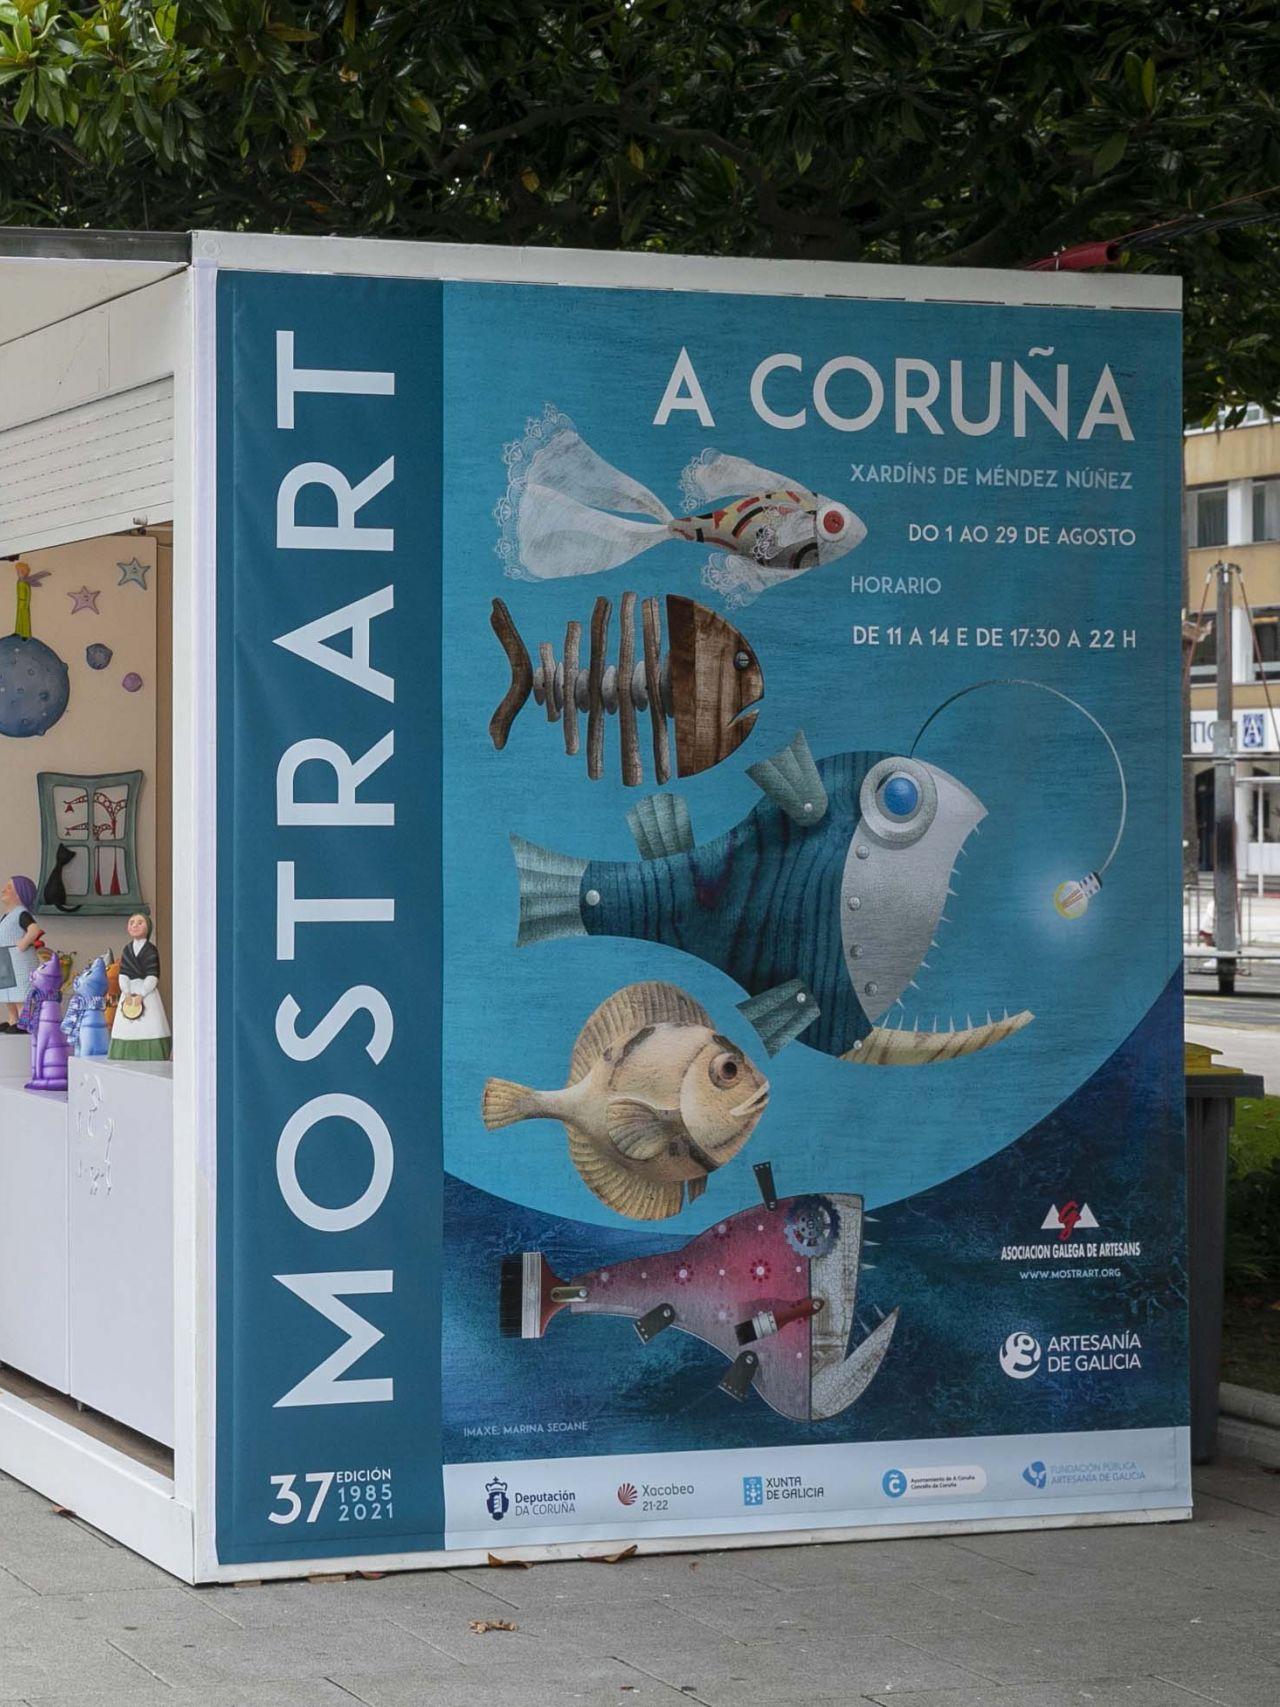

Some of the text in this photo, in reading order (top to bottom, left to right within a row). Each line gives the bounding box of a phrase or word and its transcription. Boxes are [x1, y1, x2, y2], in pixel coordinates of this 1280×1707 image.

[653, 346, 1135, 442] A CORUÑA
[850, 461, 1133, 491] XARDÍNS DE MÉNDEZ NÚÑEZ
[908, 523, 1137, 546] DO 1 AO 29 DE AGOSTO
[851, 575, 942, 595] HORARIO
[852, 625, 1137, 649] DE 11 A 14 E DE 17:30 A 22 H
[272, 330, 395, 1408] MOSTRART
[1001, 1242, 1141, 1260] ASOCIACION GALEGA DE ARTESANS
[1020, 1268, 1121, 1279] WWW.MOSTRART.ORG
[1048, 1330, 1142, 1352] ARTESANÍA
[1048, 1354, 1142, 1372] DE GALICIA
[503, 1423, 544, 1436] MARINA
[547, 1421, 589, 1433] SEOANE
[336, 1467, 391, 1483] EDICIÓN
[766, 1477, 802, 1488] XUNTA
[268, 1472, 335, 1525] 37
[338, 1484, 392, 1503] 1985
[515, 1490, 576, 1505] Deputación
[642, 1483, 695, 1497] Xacobeo
[766, 1487, 824, 1500] DE GALICIA
[339, 1503, 393, 1522] 2021
[515, 1502, 576, 1516] DA CORUÑA
